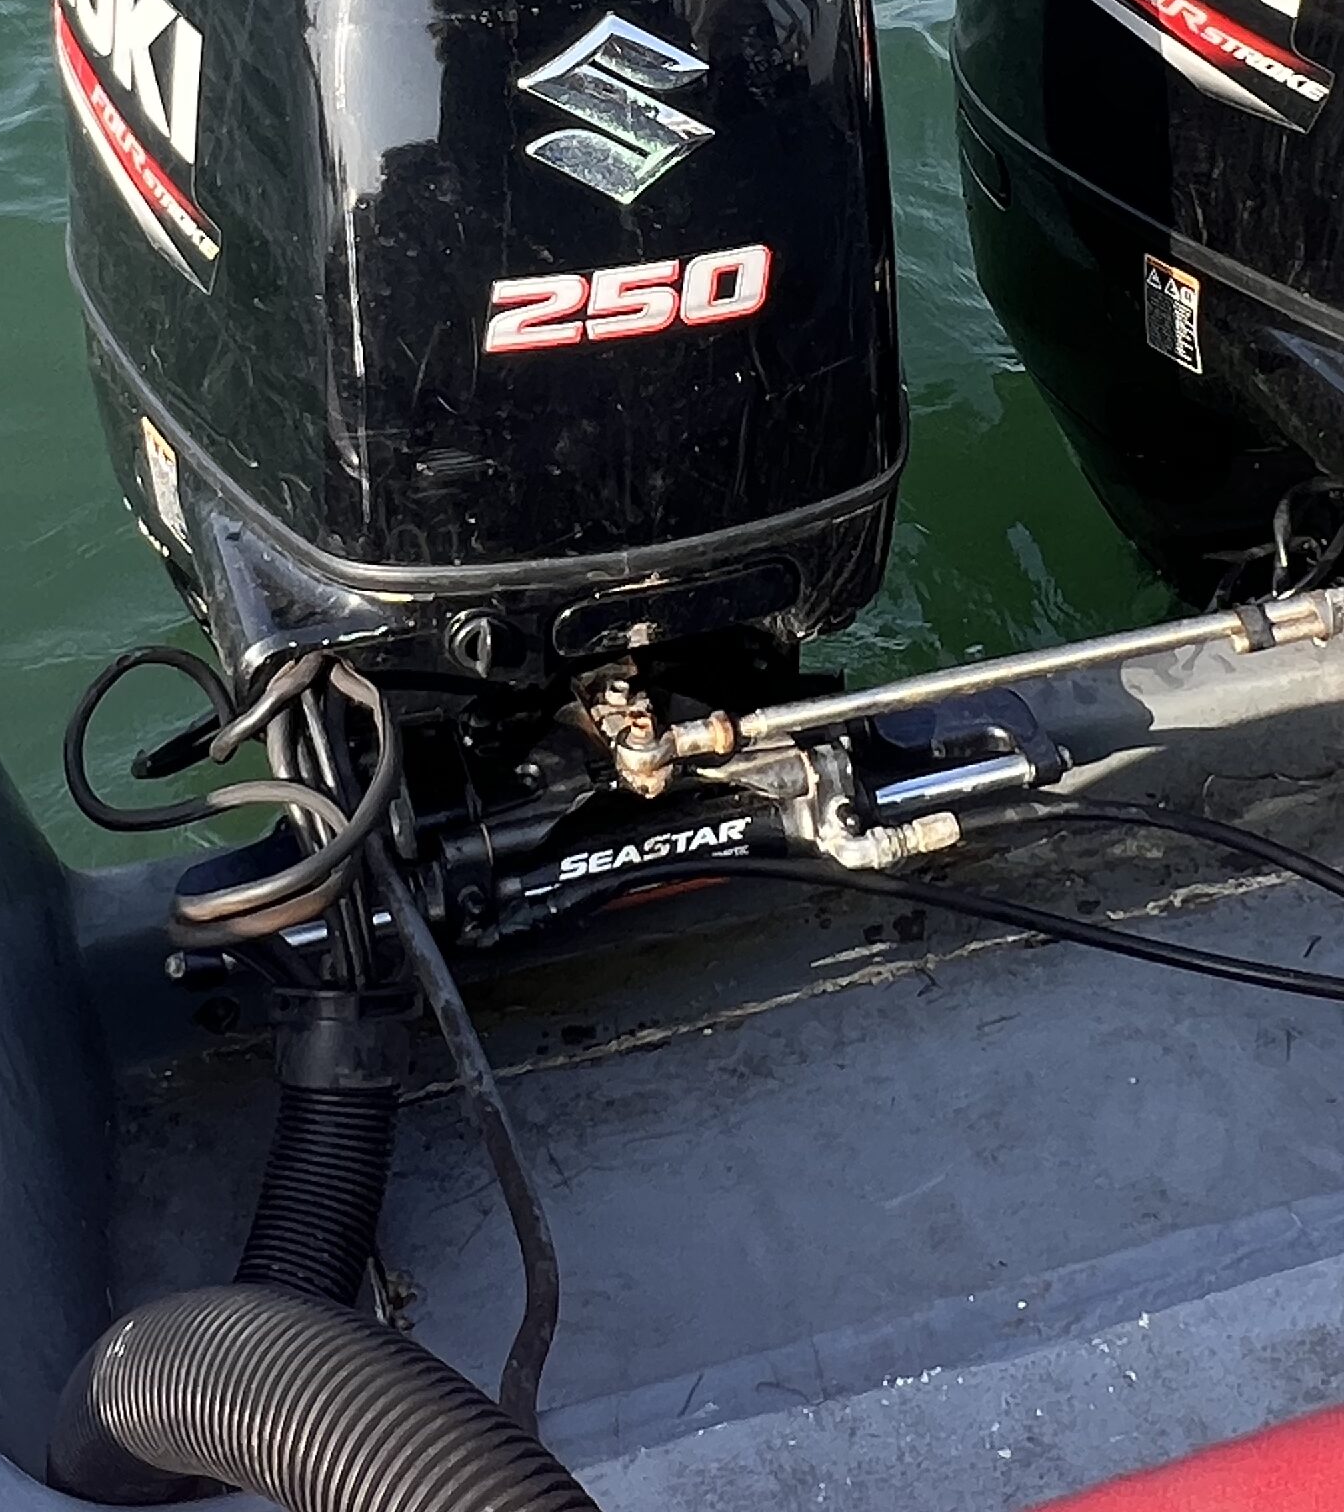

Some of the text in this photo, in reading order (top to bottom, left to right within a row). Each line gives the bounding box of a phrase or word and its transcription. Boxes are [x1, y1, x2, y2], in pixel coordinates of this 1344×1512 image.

[1201, 26, 1330, 102] STROKE
[90, 82, 147, 174] FOUR
[484, 244, 774, 353] 250
[559, 817, 752, 881] SEASTAR
